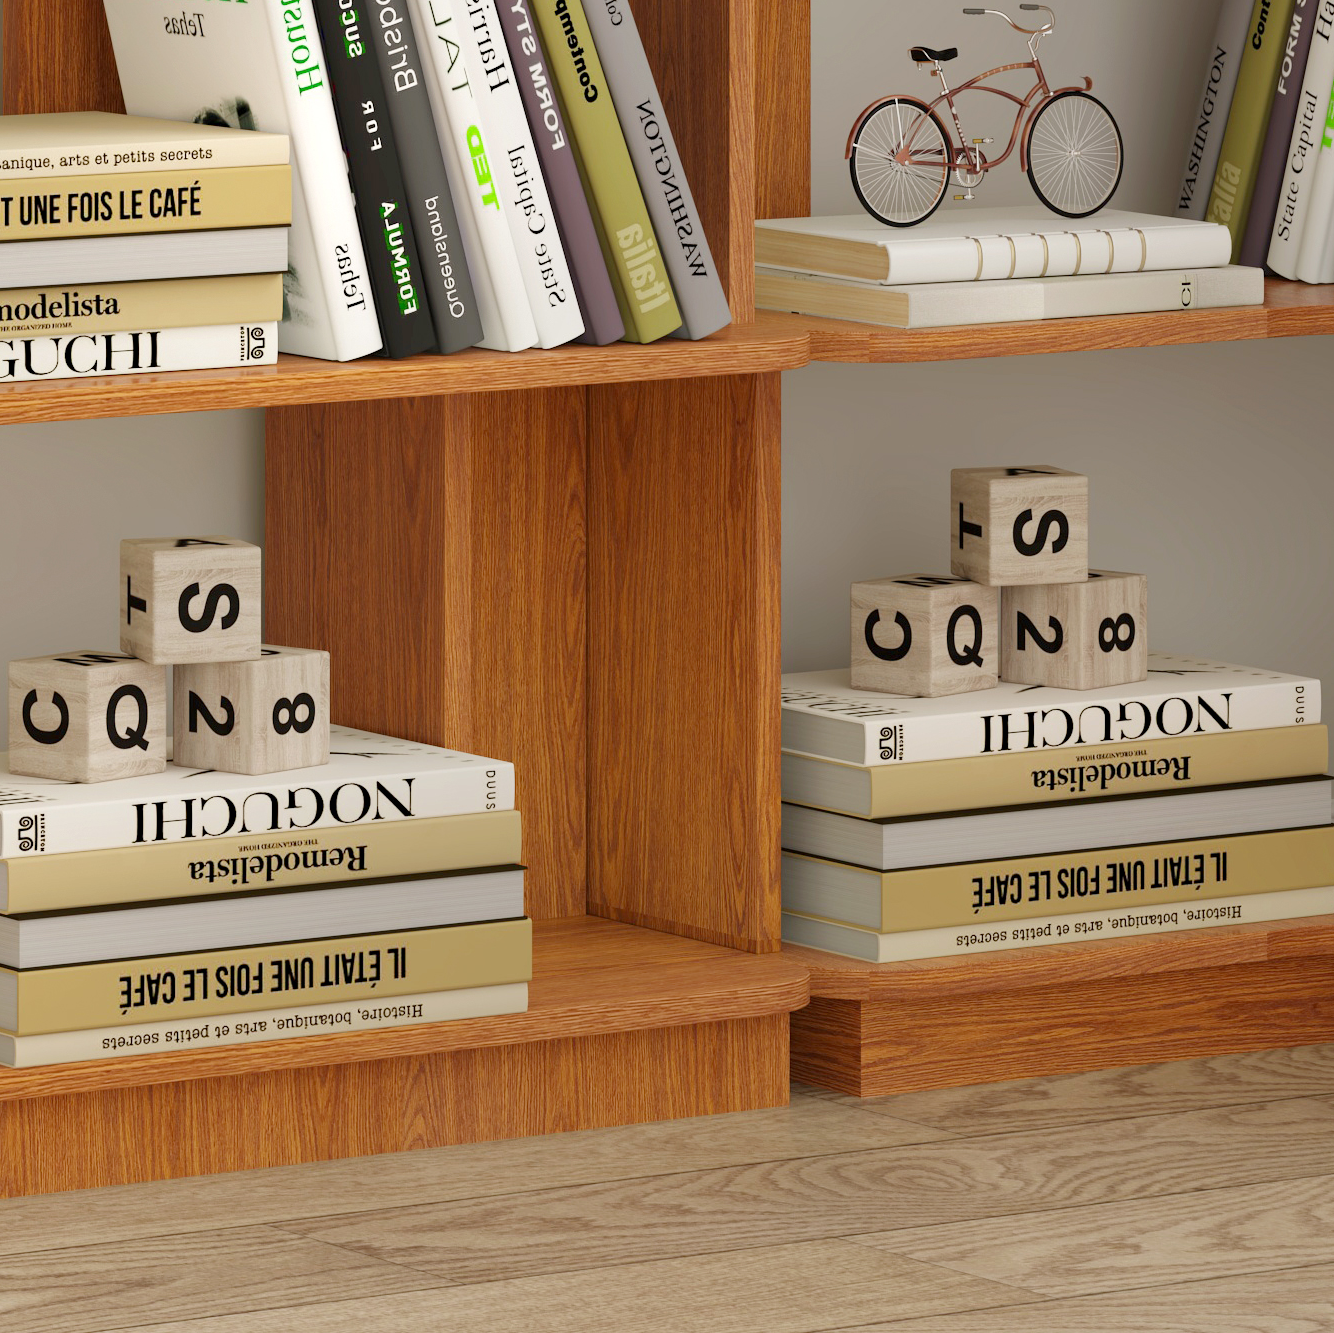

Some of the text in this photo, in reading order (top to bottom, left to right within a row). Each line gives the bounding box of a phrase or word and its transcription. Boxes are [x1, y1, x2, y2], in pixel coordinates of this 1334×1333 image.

[1277, 13, 1303, 95] FORM
[1178, 45, 1227, 210] WASHINGTON
[59, 154, 90, 167] arts
[94, 152, 109, 165] et
[113, 150, 155, 167] petits
[160, 147, 213, 162] secrets
[19, 194, 61, 226] UNE
[67, 191, 113, 223] FOIS
[119, 189, 143, 220] LE
[149, 180, 202, 219] CAFÉ
[1012, 508, 1069, 557] S
[178, 582, 240, 633] S
[1016, 610, 1064, 654] 2
[864, 608, 913, 662] C
[946, 604, 984, 668] Q
[1098, 612, 1136, 654] 8
[22, 688, 70, 745] C
[105, 684, 150, 752] Q
[188, 690, 235, 737] 2
[272, 692, 316, 735] 8
[979, 693, 1234, 754] NOGUCHI
[1031, 755, 1191, 793] Remodelista
[131, 778, 417, 844] NOGUCHI
[187, 843, 369, 885] Remodelista
